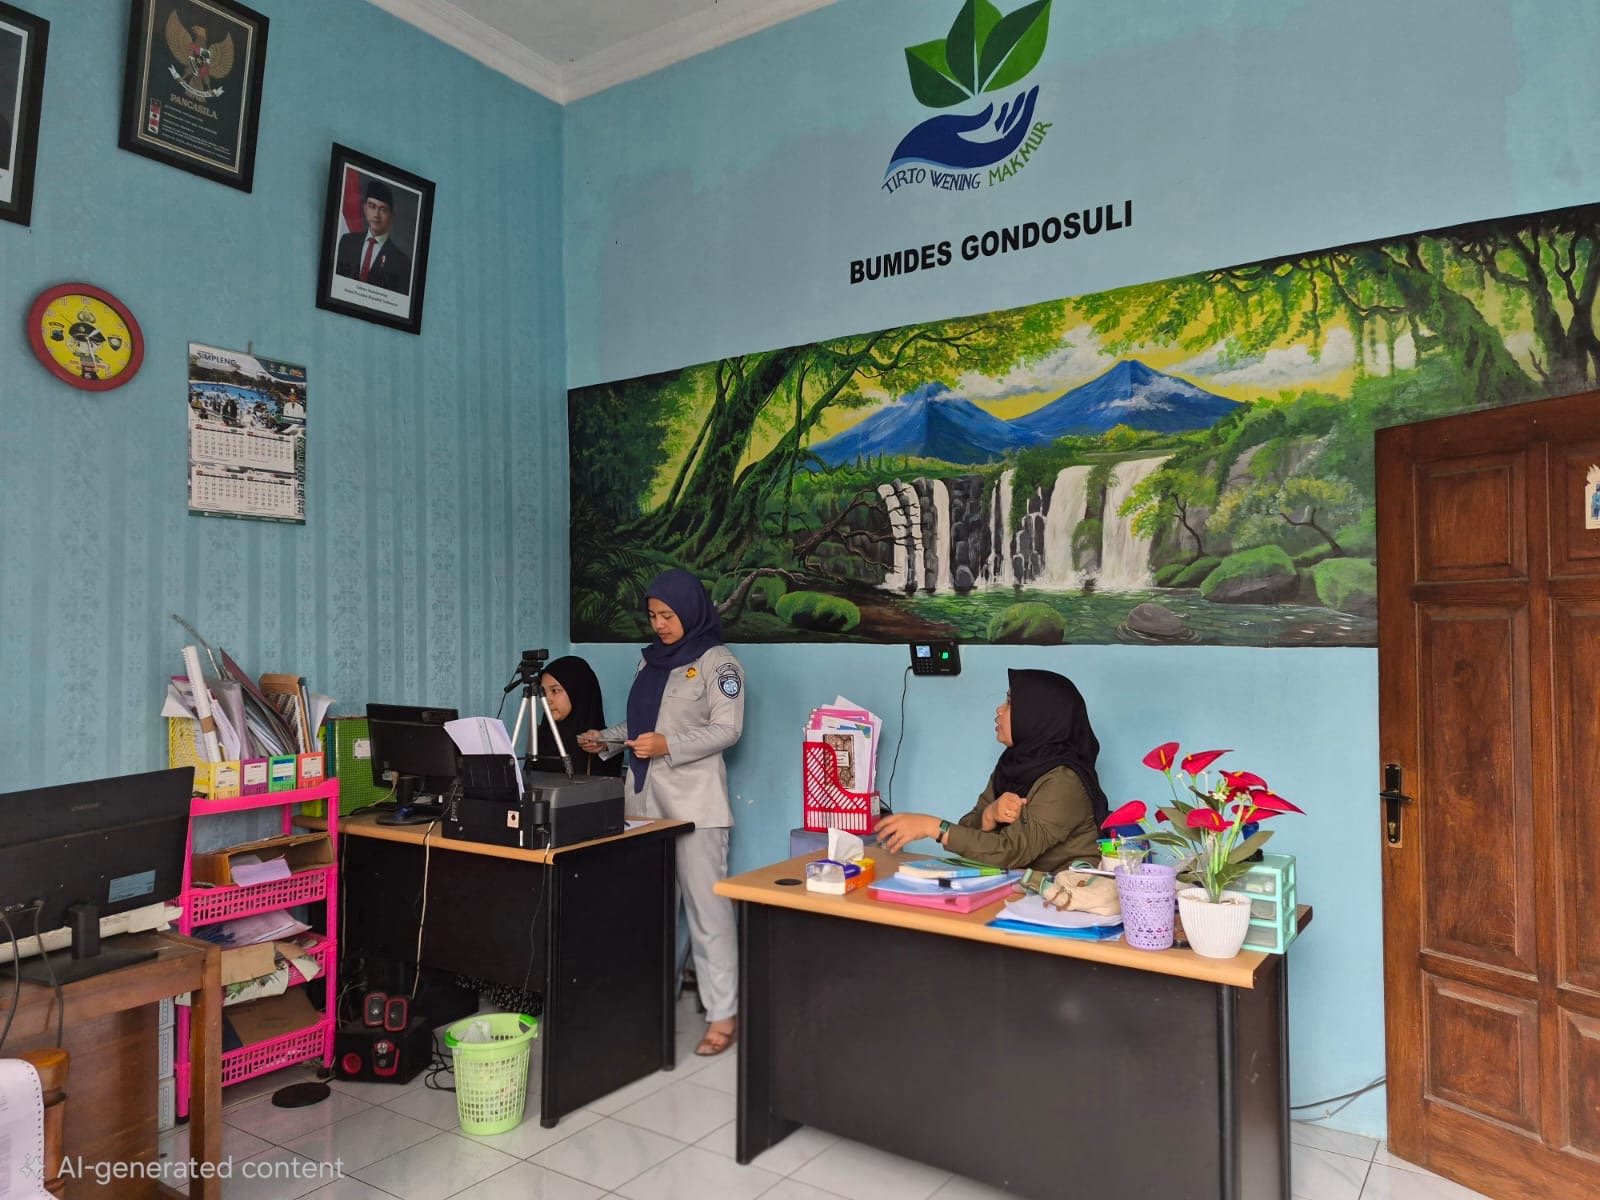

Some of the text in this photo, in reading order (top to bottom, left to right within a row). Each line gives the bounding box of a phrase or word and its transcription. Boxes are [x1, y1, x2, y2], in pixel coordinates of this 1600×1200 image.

[170, 93, 218, 120] PANCASILA
[881, 121, 1052, 194] TIRTO WENING MAKMUR
[850, 200, 1132, 284] BUMDES GONDOSULI
